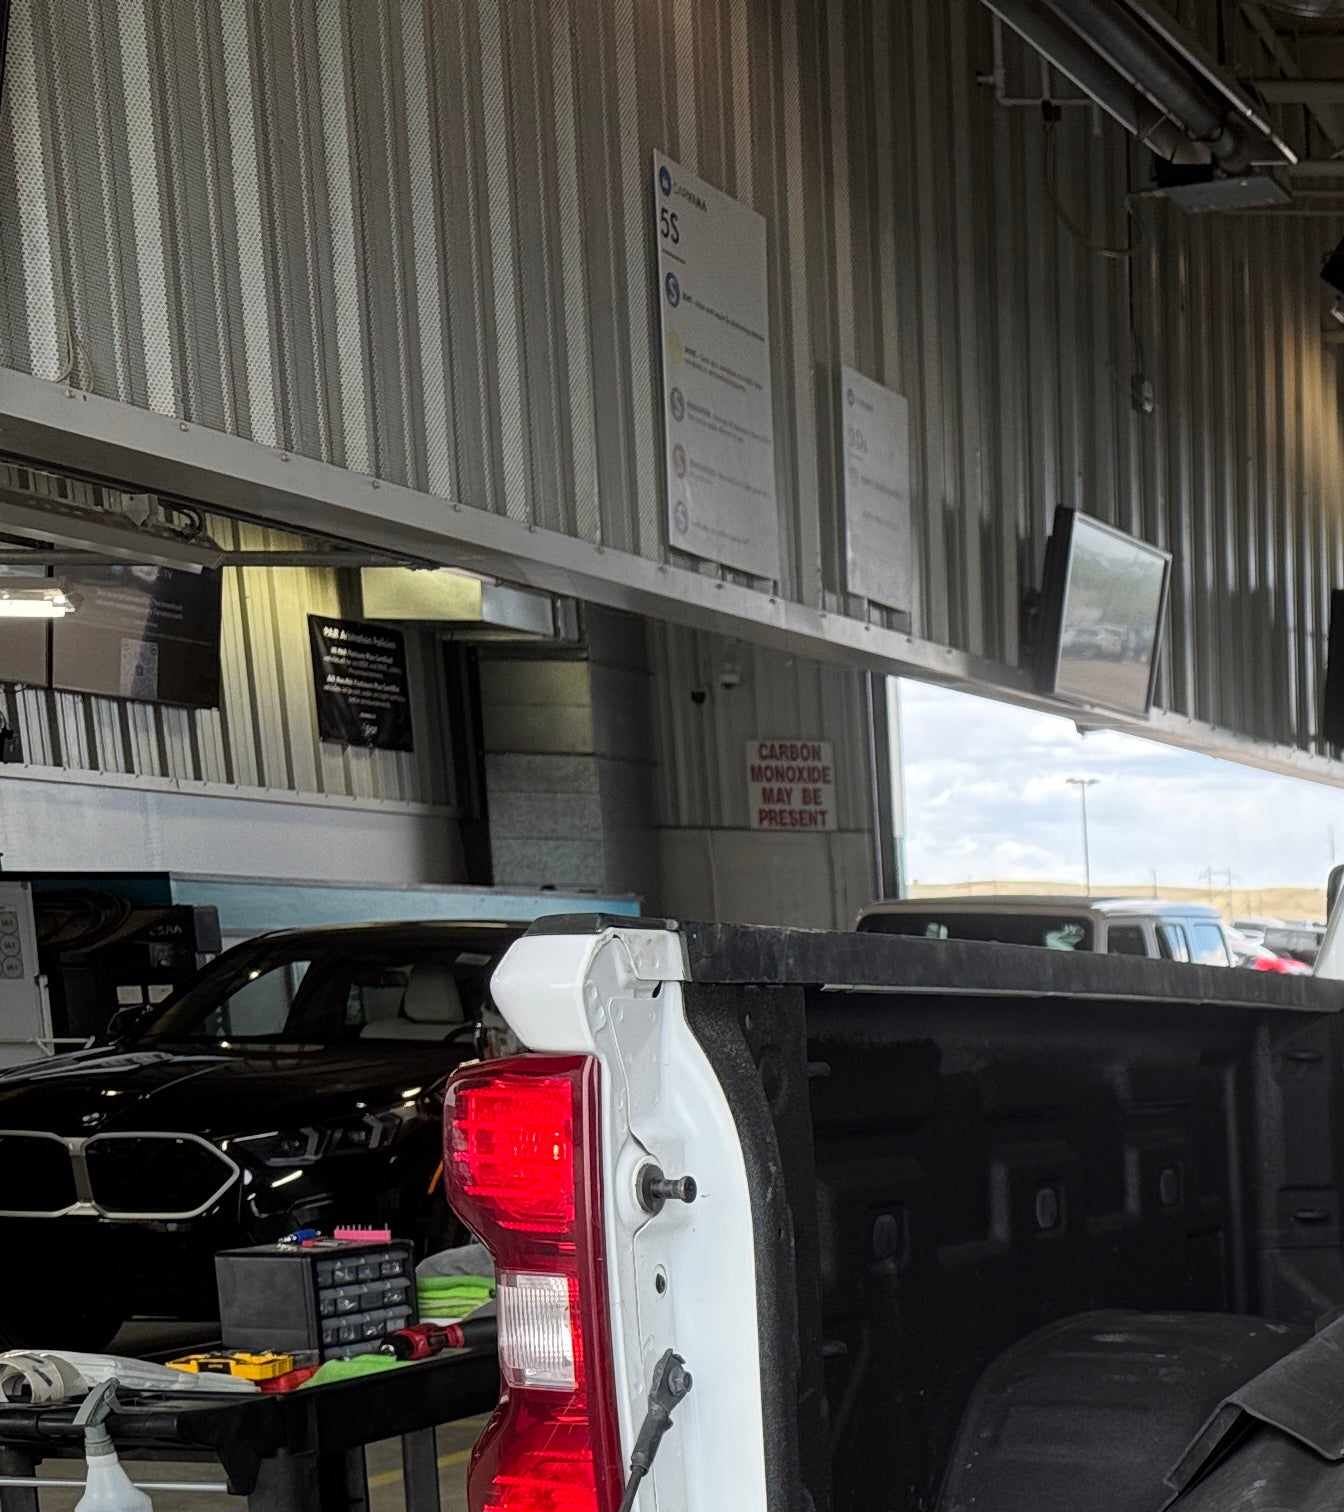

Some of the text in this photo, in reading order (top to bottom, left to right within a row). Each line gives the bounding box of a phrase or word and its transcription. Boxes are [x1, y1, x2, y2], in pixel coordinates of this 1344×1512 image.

[659, 206, 680, 245] 5S
[758, 743, 822, 762] CARBON
[750, 765, 832, 784] MONOXIDE
[762, 787, 822, 806] MAY BE
[758, 808, 828, 827] PRESENT
